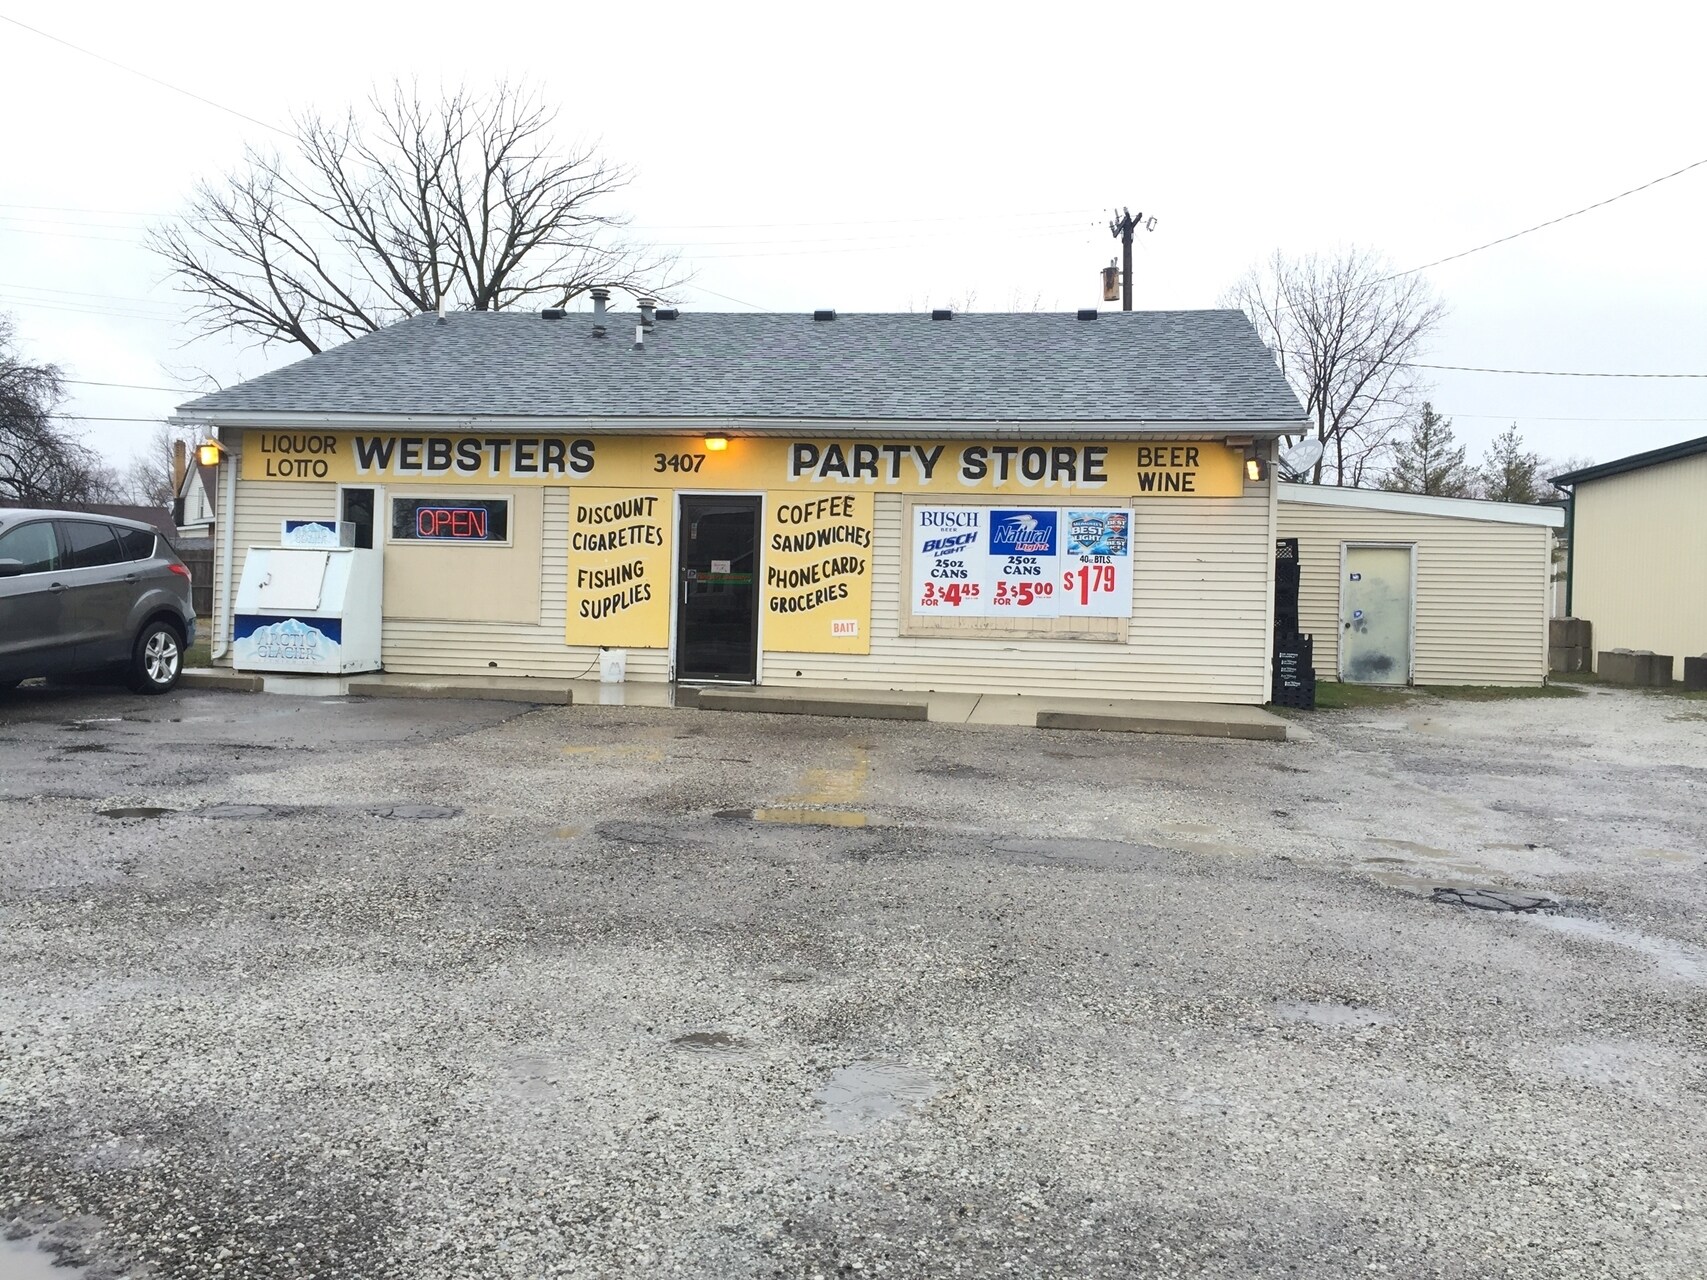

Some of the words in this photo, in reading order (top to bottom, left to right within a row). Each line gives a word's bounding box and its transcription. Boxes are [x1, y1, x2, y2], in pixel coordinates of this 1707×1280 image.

[261, 434, 337, 454] LIQUOR
[352, 436, 597, 476] WEBSTERS
[653, 453, 706, 473] 3407
[788, 443, 946, 483] PARTY
[959, 445, 1109, 486] STORE
[1137, 447, 1199, 468] BEER
[266, 458, 329, 478] LOTTO
[1137, 472, 1196, 493] WINE
[577, 496, 658, 524] DISCOUNT
[777, 496, 855, 524] COFFEE
[920, 511, 979, 528] BUSCH
[418, 509, 486, 538] OPEN
[1071, 526, 1104, 535] BEST
[572, 525, 663, 551] CIGARETTES
[771, 525, 871, 552] SANDWICHES
[922, 531, 978, 553] BUSCH
[993, 525, 1053, 544] Natural
[934, 545, 966, 557] LIGHT
[1015, 542, 1050, 552] Light
[577, 560, 644, 589] FISHING
[768, 565, 821, 589] PHONE
[822, 556, 865, 585] CARDS
[931, 569, 968, 579] CANS
[1003, 566, 1041, 576] CANS
[770, 583, 848, 613] GROCERIES
[924, 582, 935, 598] 3
[996, 581, 1008, 597] 5
[579, 583, 651, 619] SUPPLIES
[993, 598, 1011, 606] FOR
[833, 622, 855, 633] BAIT
[257, 629, 317, 648] ARCTIC
[257, 645, 317, 660] GLACIER
